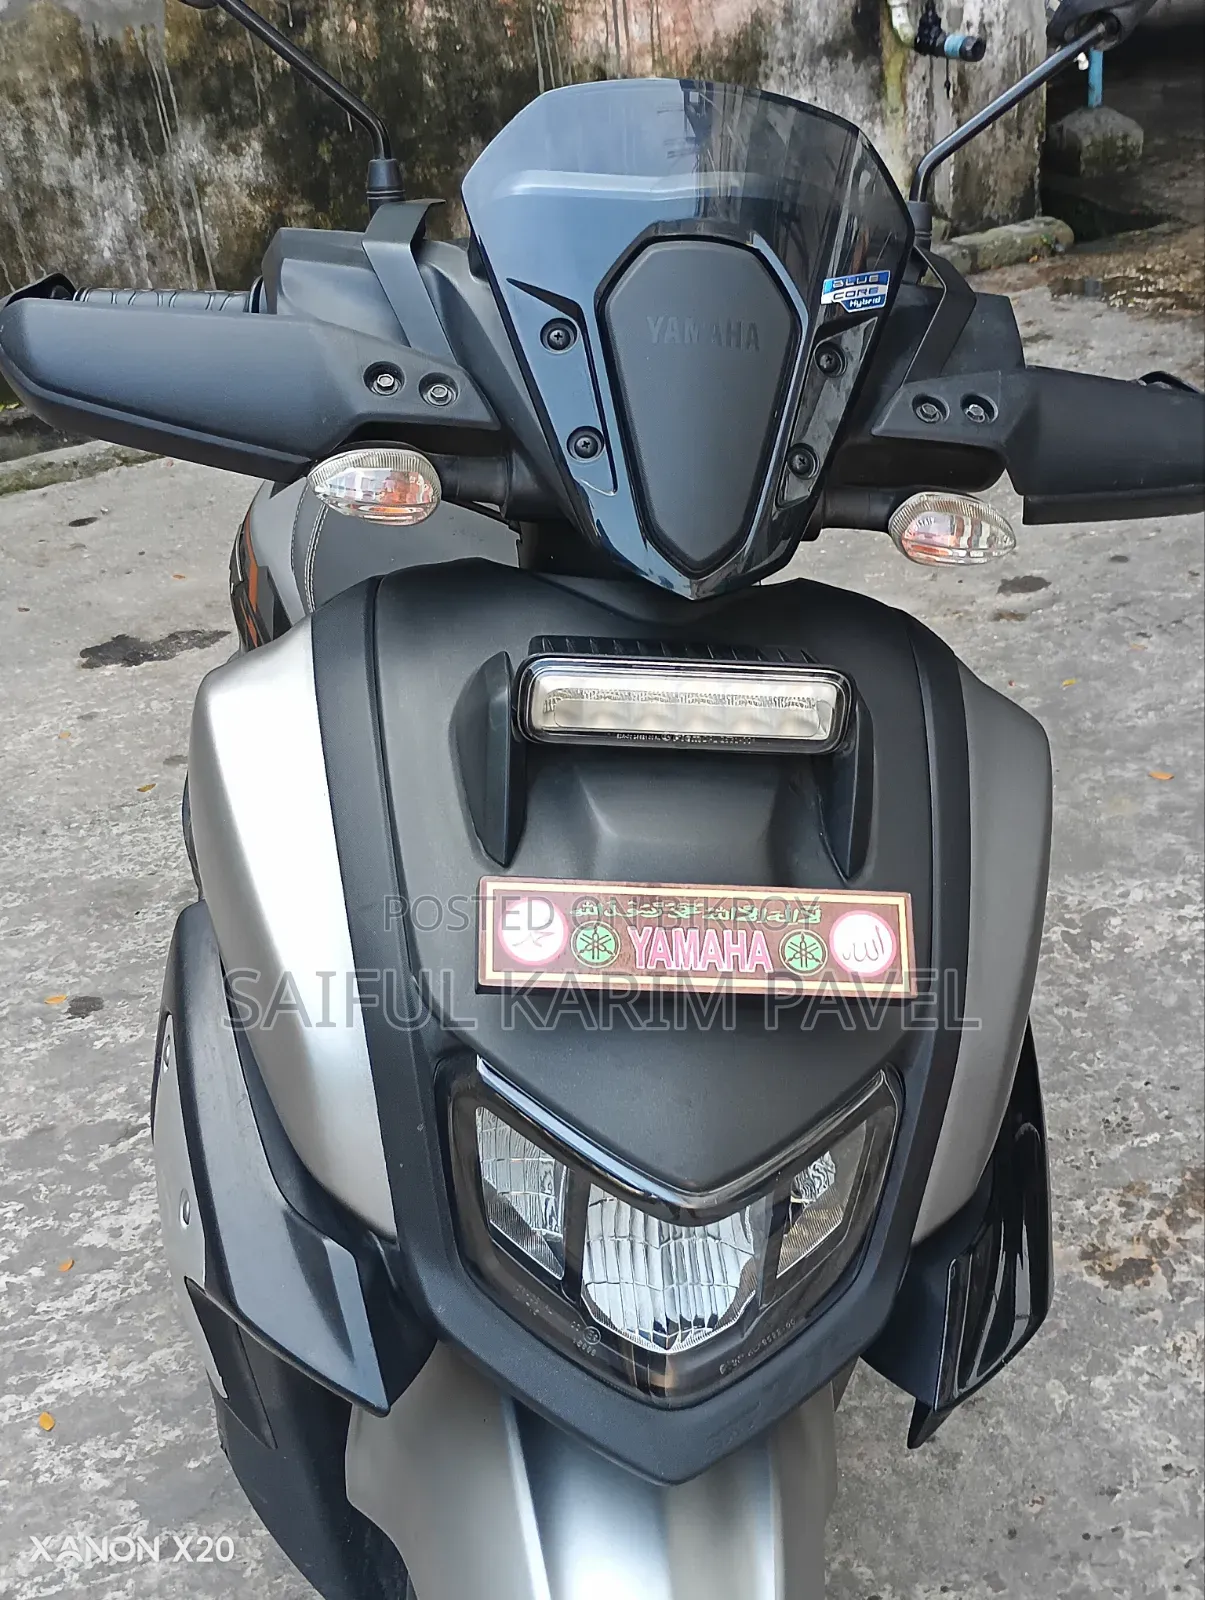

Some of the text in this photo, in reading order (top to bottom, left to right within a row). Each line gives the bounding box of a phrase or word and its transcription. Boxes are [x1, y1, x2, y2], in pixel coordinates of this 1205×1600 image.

[833, 274, 879, 289] BLUE
[833, 286, 879, 300] CORE
[849, 296, 881, 308] Hybrid
[646, 316, 760, 352] YAMAHA
[627, 926, 774, 973] YAMAHA
